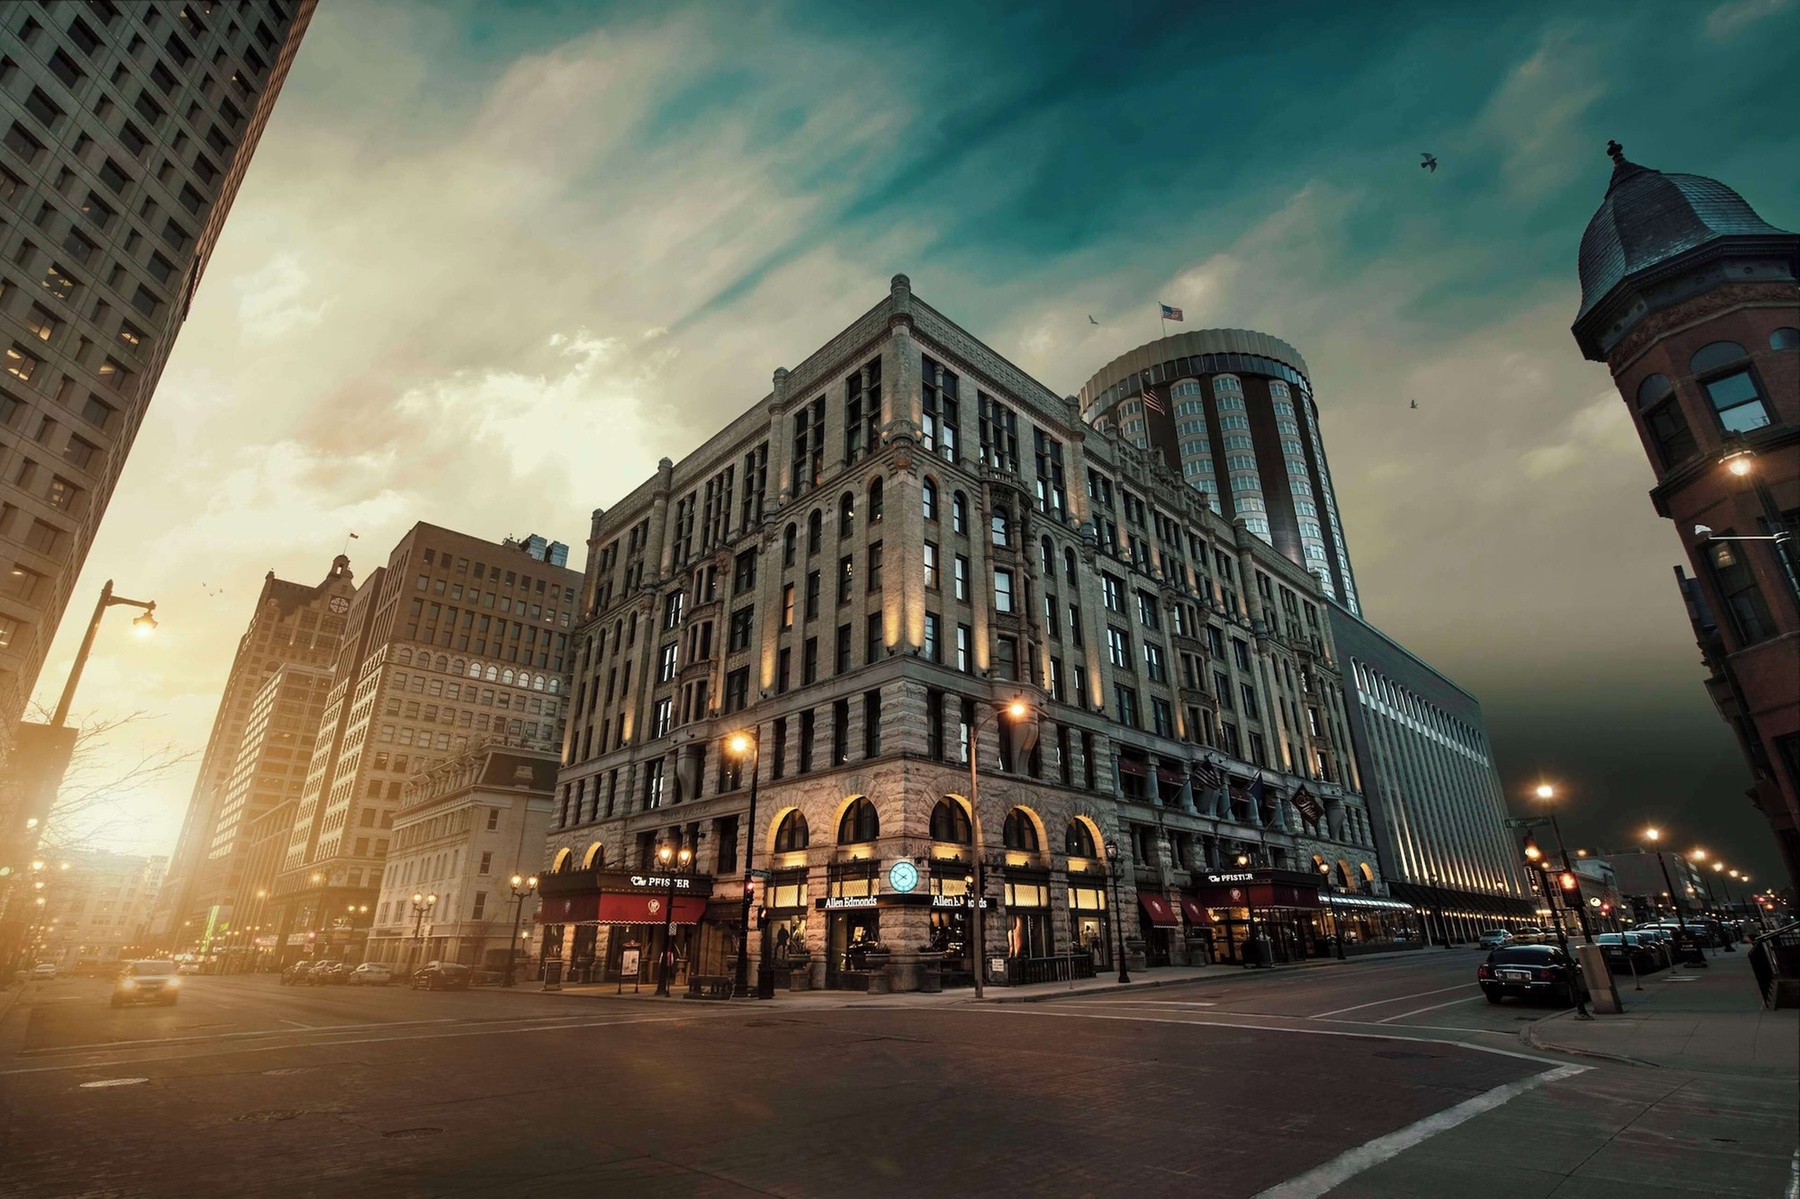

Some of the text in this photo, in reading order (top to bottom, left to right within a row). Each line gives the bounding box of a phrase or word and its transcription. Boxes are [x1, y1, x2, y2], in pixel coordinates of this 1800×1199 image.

[630, 876, 690, 888] The PFISER
[825, 895, 877, 908] Allen Edmonds
[933, 895, 953, 906] Allen
